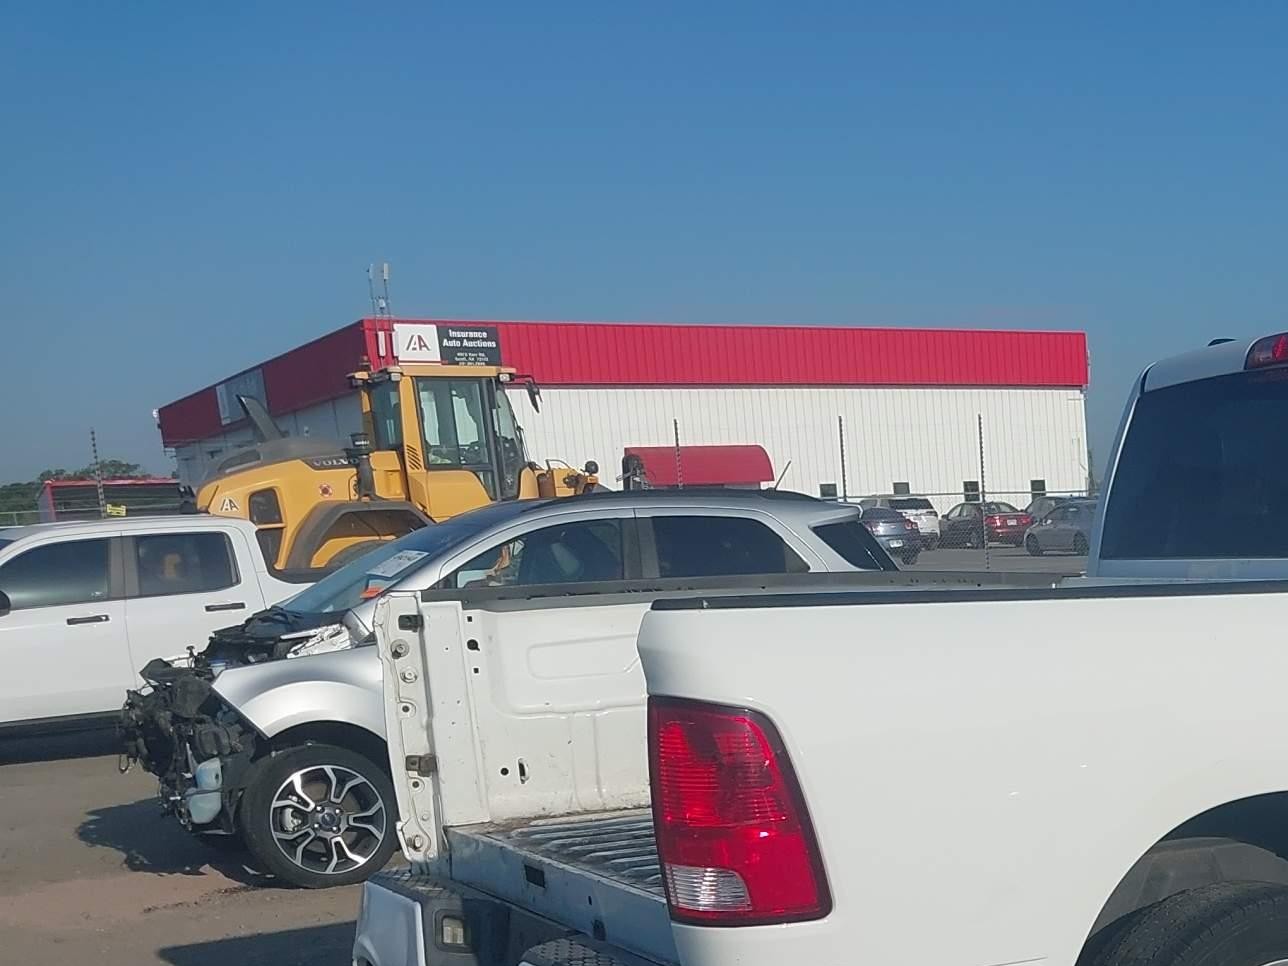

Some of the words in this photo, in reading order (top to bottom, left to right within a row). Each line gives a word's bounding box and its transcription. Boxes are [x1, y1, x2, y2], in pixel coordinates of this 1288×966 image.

[448, 328, 488, 338] Insurance
[442, 339, 461, 347] Auto
[462, 339, 497, 348] Auctions
[313, 457, 360, 467] VOLVO
